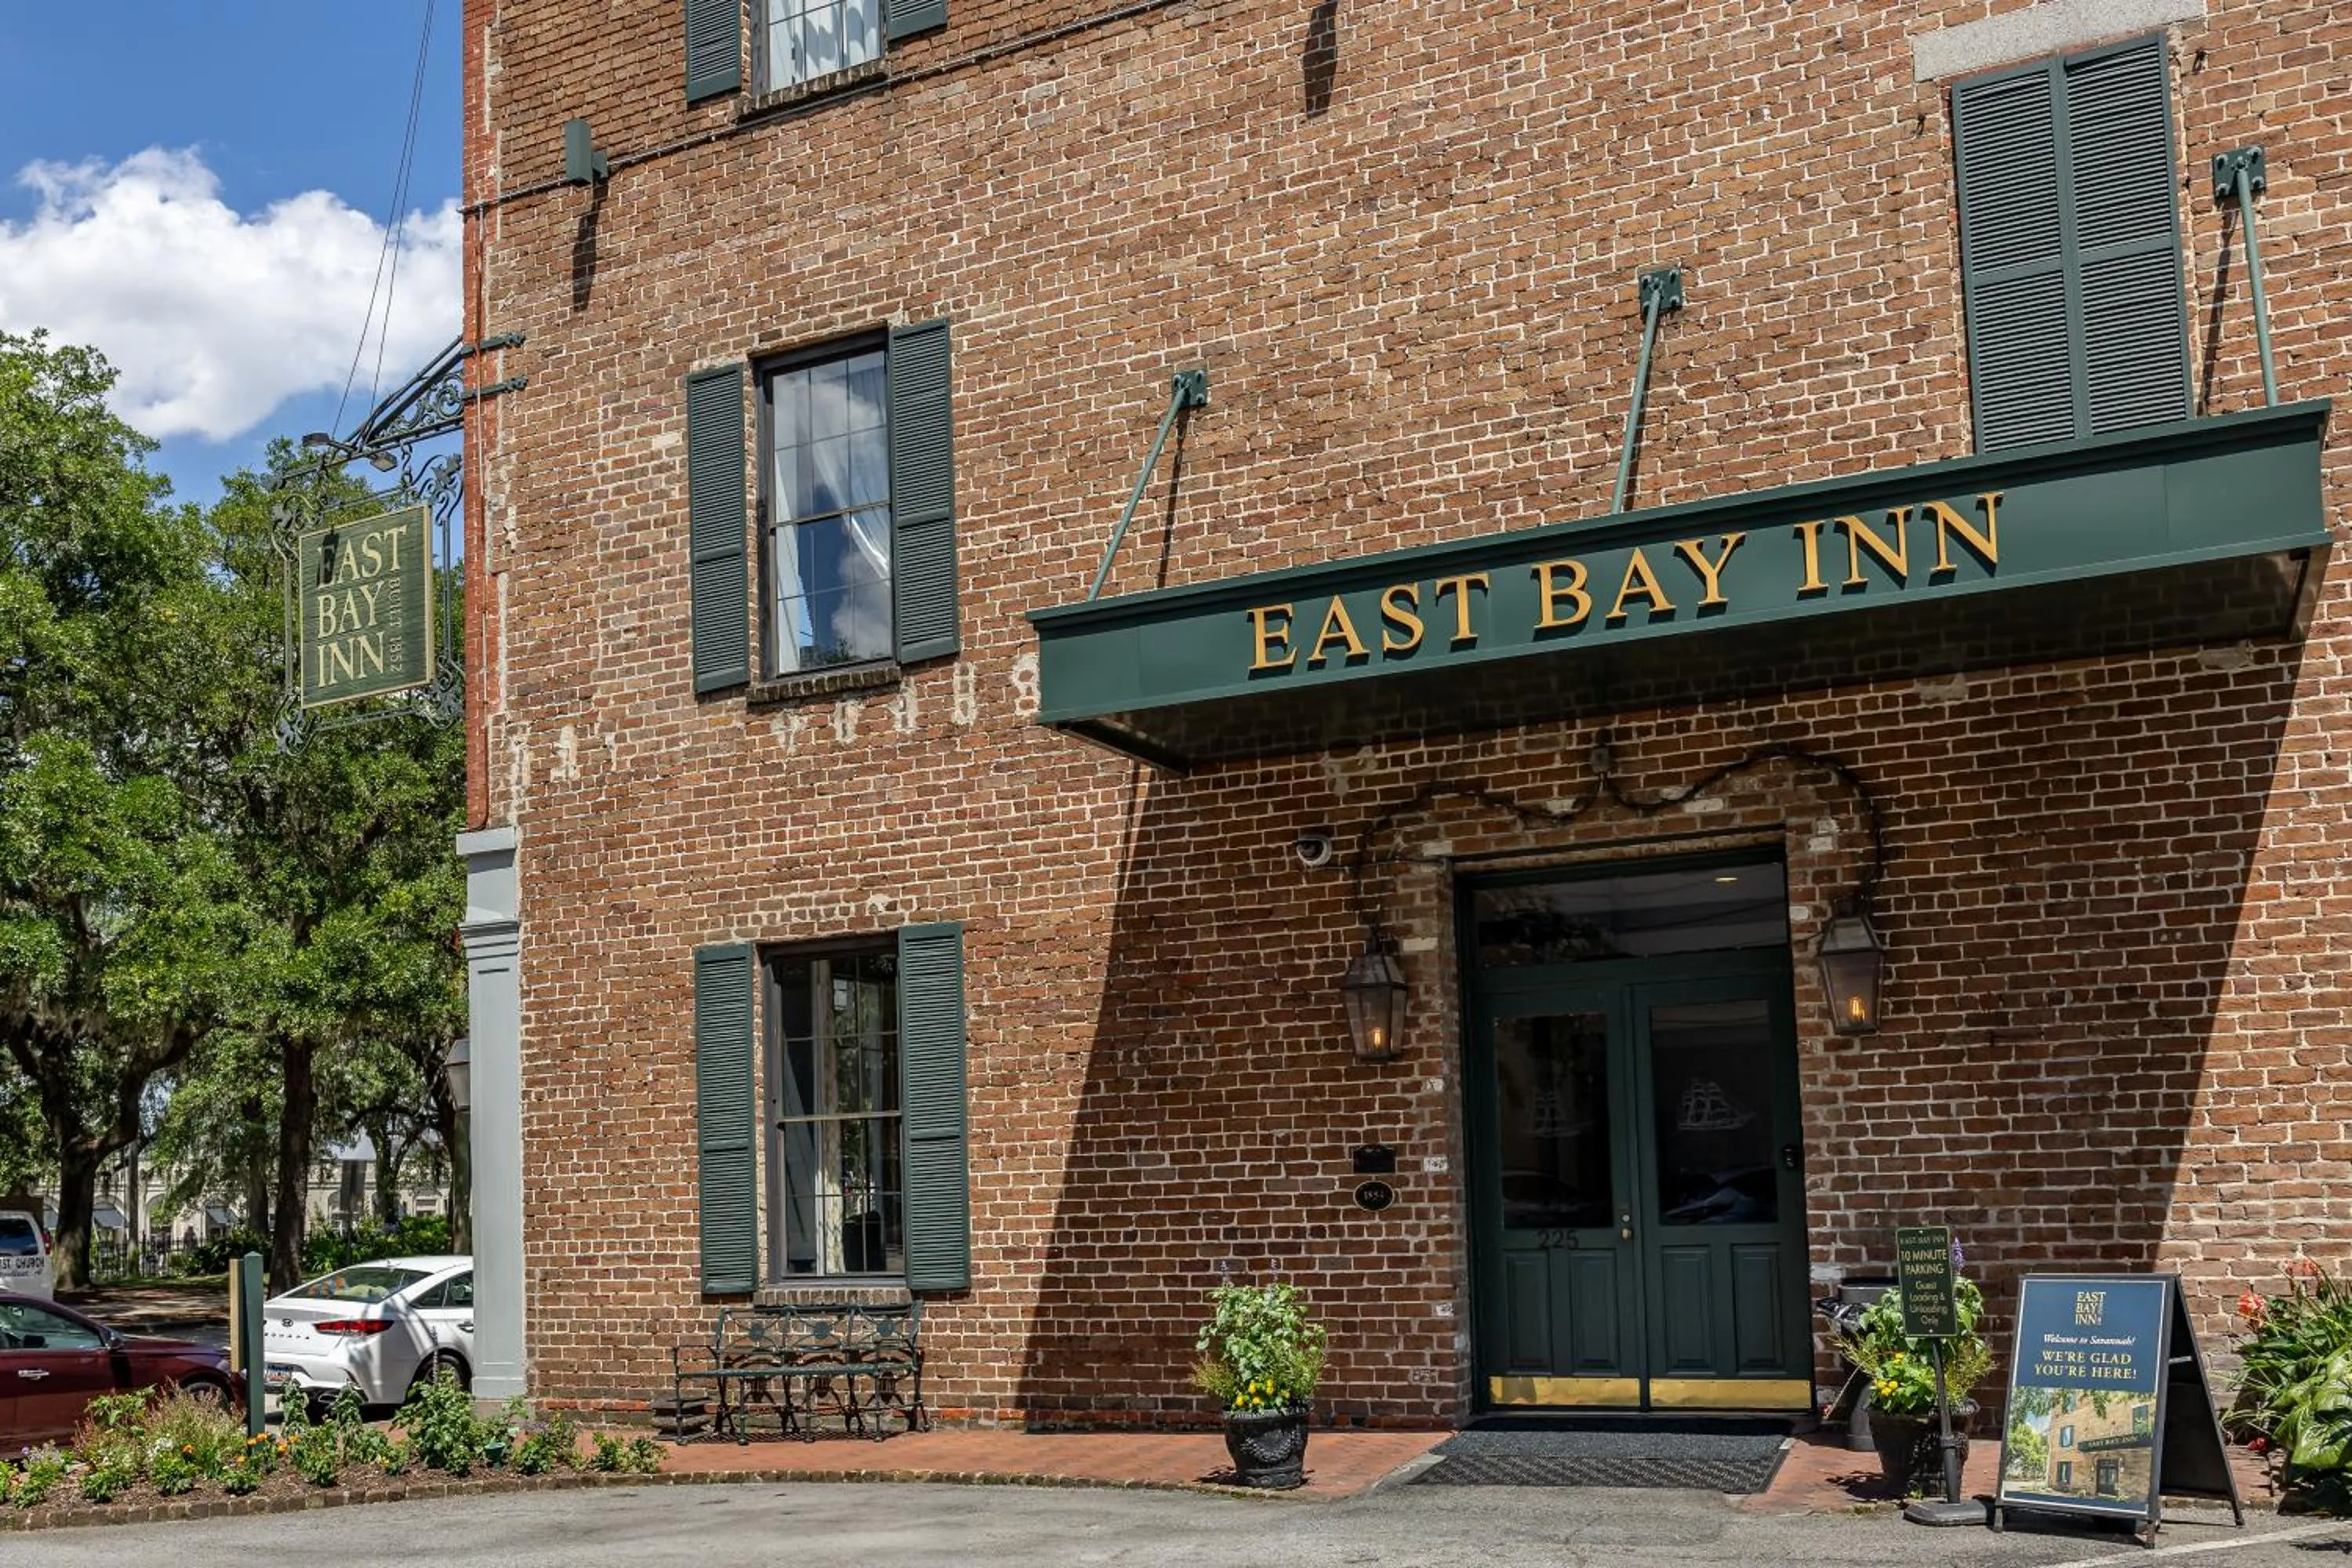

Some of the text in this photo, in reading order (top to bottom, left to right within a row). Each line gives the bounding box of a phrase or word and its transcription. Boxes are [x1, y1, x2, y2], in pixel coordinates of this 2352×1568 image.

[317, 526, 407, 588] EAST
[1247, 492, 2005, 670] EAST BAY INN
[388, 578, 402, 628] BUILT
[317, 580, 385, 639] BAY
[317, 632, 384, 688] INN
[1537, 1229, 1579, 1250] 225
[1900, 1249, 1948, 1261] 10 MINUTE
[16, 1256, 45, 1269] CHURCH
[1905, 1263, 1944, 1275] PARKING
[1915, 1280, 1937, 1290] Guest
[1909, 1292, 1939, 1303] Loading
[2076, 1291, 2107, 1301] EAST
[1909, 1304, 1948, 1315] Unloading
[2075, 1302, 2099, 1314] BAY
[1920, 1315, 1939, 1326] Only
[2074, 1314, 2098, 1325] INN
[2044, 1334, 2078, 1343] Welcome
[2042, 1350, 2132, 1364] WE'RE GLAD
[2034, 1364, 2137, 1379] YOU'RE HERE!
